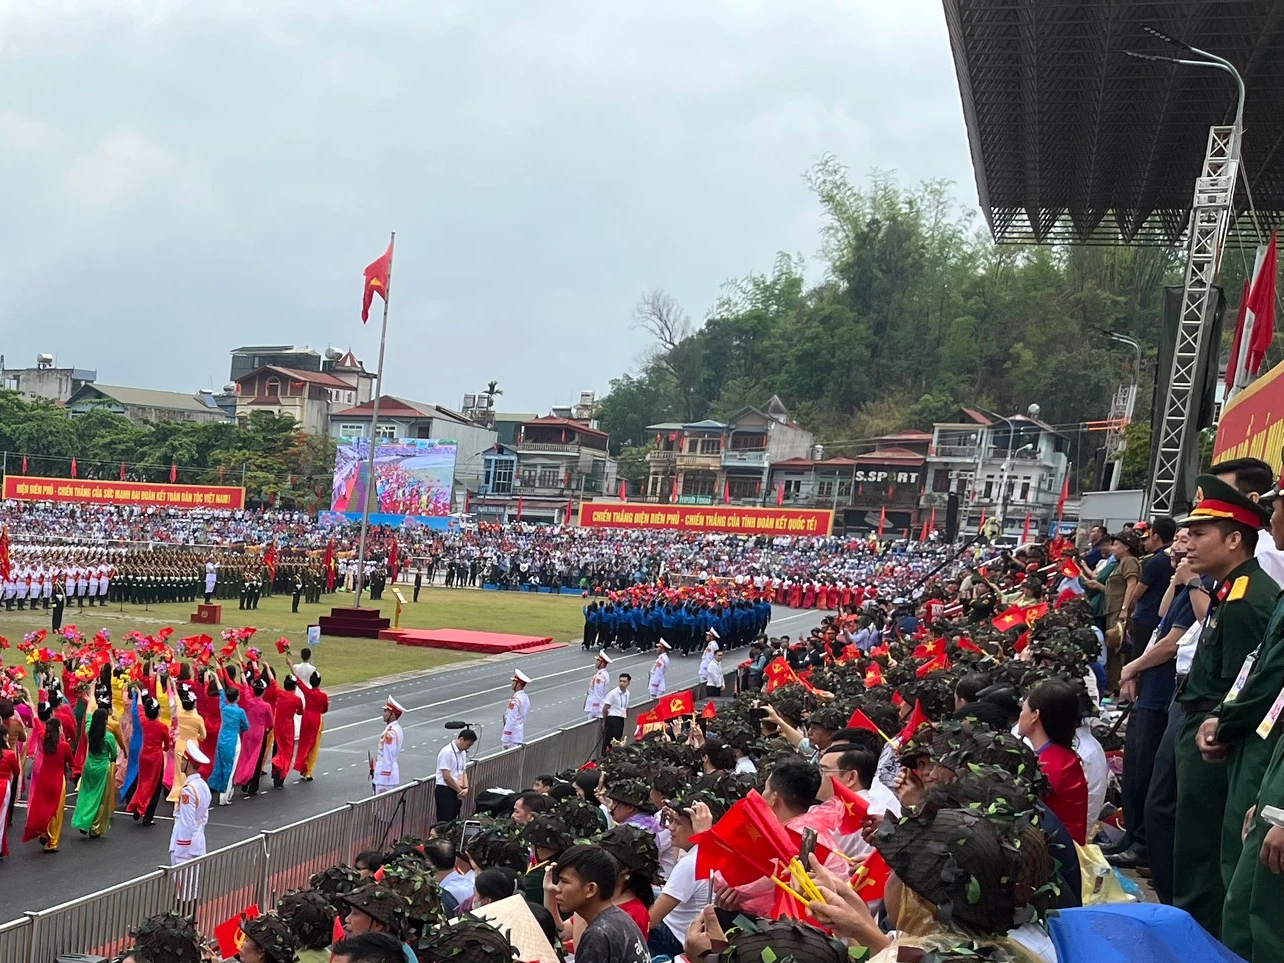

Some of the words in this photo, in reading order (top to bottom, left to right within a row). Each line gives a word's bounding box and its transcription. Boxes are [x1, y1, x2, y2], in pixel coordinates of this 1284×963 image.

[592, 508, 612, 522] CHIẾN
[612, 508, 634, 523] THẮNG
[633, 511, 650, 526] ĐIỆN
[650, 511, 667, 525] BIÊN
[666, 511, 680, 525] PHỦ
[684, 511, 704, 526] CHIẾN
[705, 511, 727, 527] THẮNG
[727, 513, 740, 527] CỦA
[775, 515, 787, 529] KẾT
[788, 515, 806, 531] QUỐC
